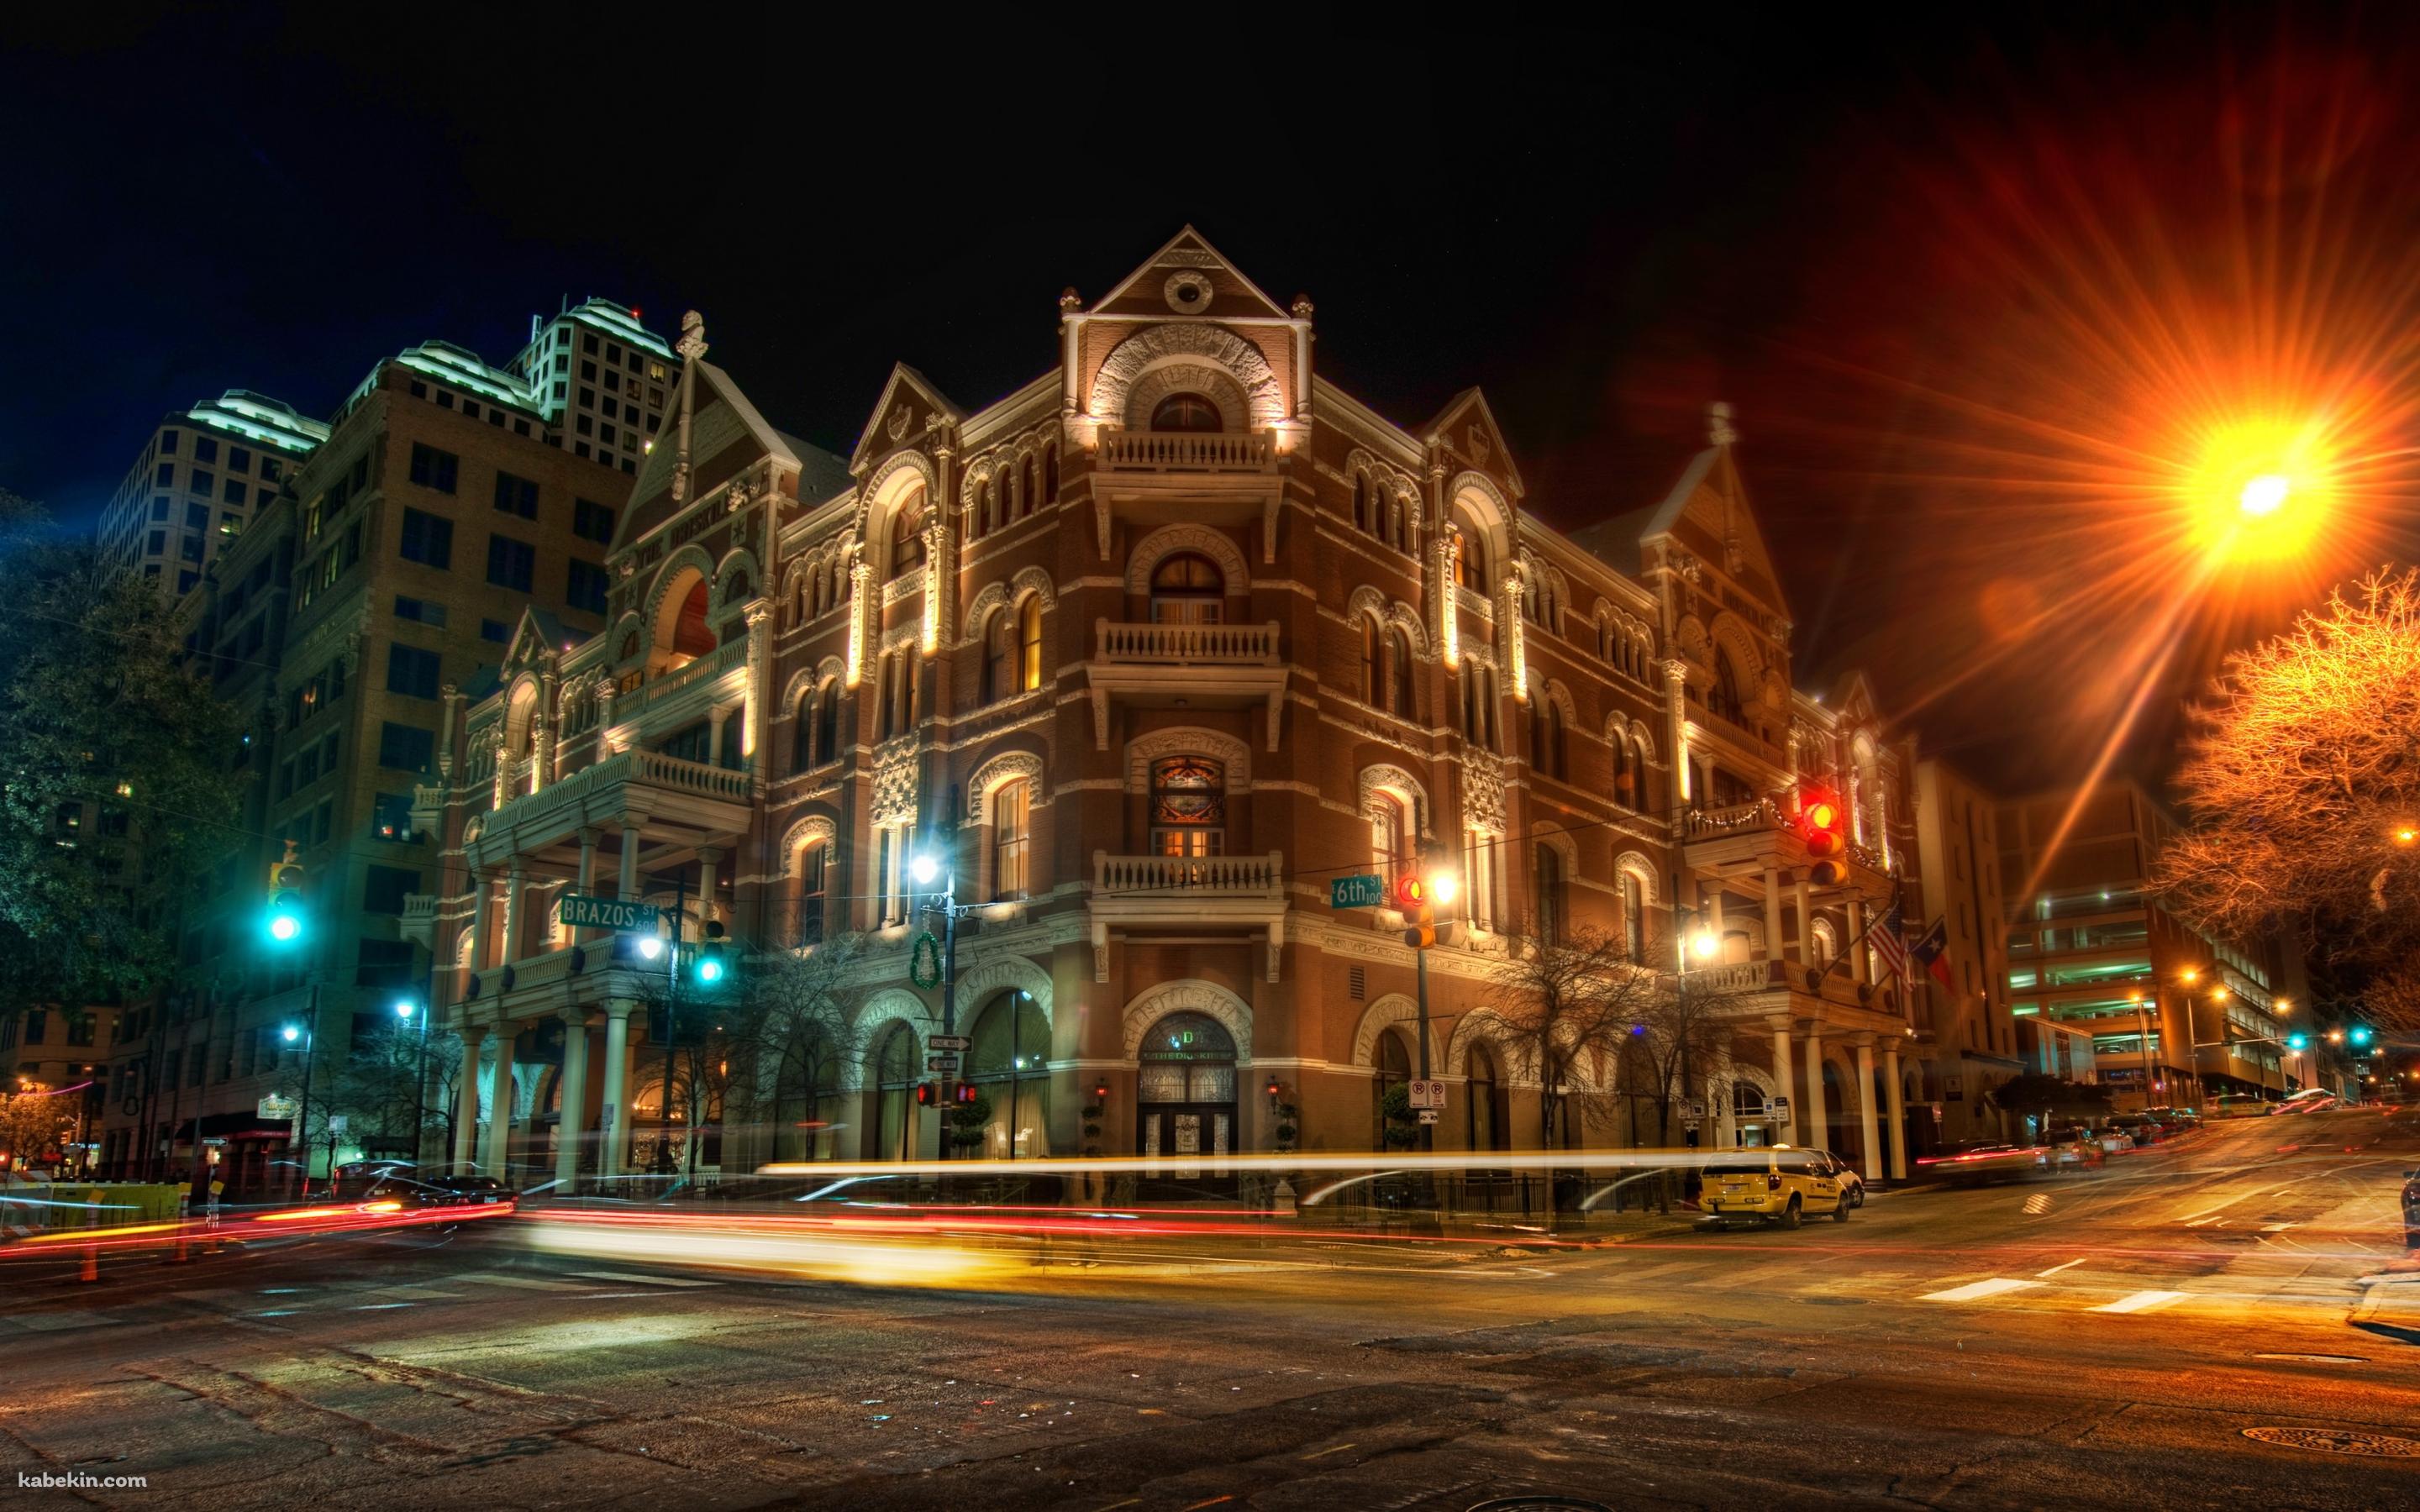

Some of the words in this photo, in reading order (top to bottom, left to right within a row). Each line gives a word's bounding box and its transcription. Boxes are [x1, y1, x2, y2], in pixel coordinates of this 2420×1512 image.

[1337, 880, 1365, 903] 6th
[1370, 875, 1381, 887] ST
[1366, 892, 1382, 904] 100
[564, 899, 634, 927] BRAZOS
[643, 905, 655, 916] ST
[636, 920, 656, 932] 600
